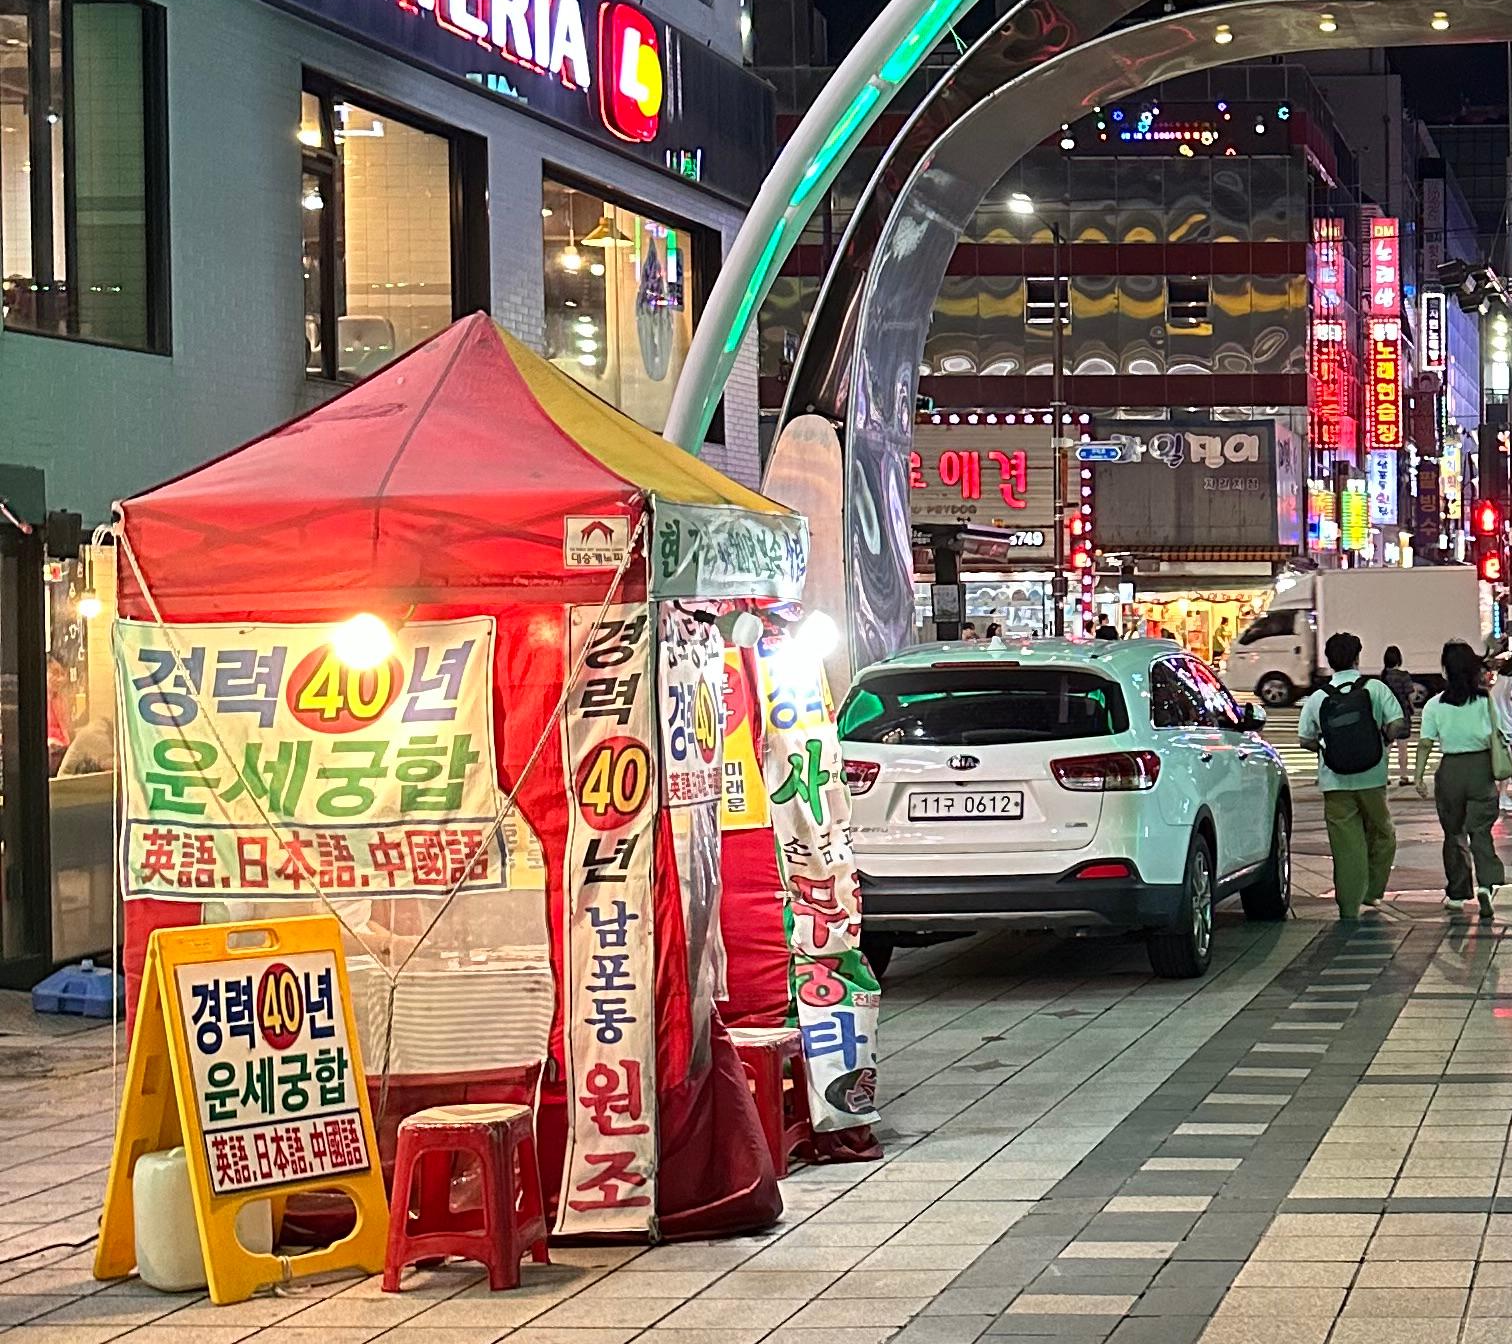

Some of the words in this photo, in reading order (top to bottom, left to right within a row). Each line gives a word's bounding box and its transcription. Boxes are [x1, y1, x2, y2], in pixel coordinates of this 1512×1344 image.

[146, 734, 481, 818] 운세궁합
[951, 757, 976, 768] KIA
[920, 797, 955, 814] 11구
[964, 795, 1011, 813] 0612
[584, 899, 638, 1045] 남포동
[204, 1047, 349, 1122] 운세궁합
[568, 1060, 651, 1213] 원조
